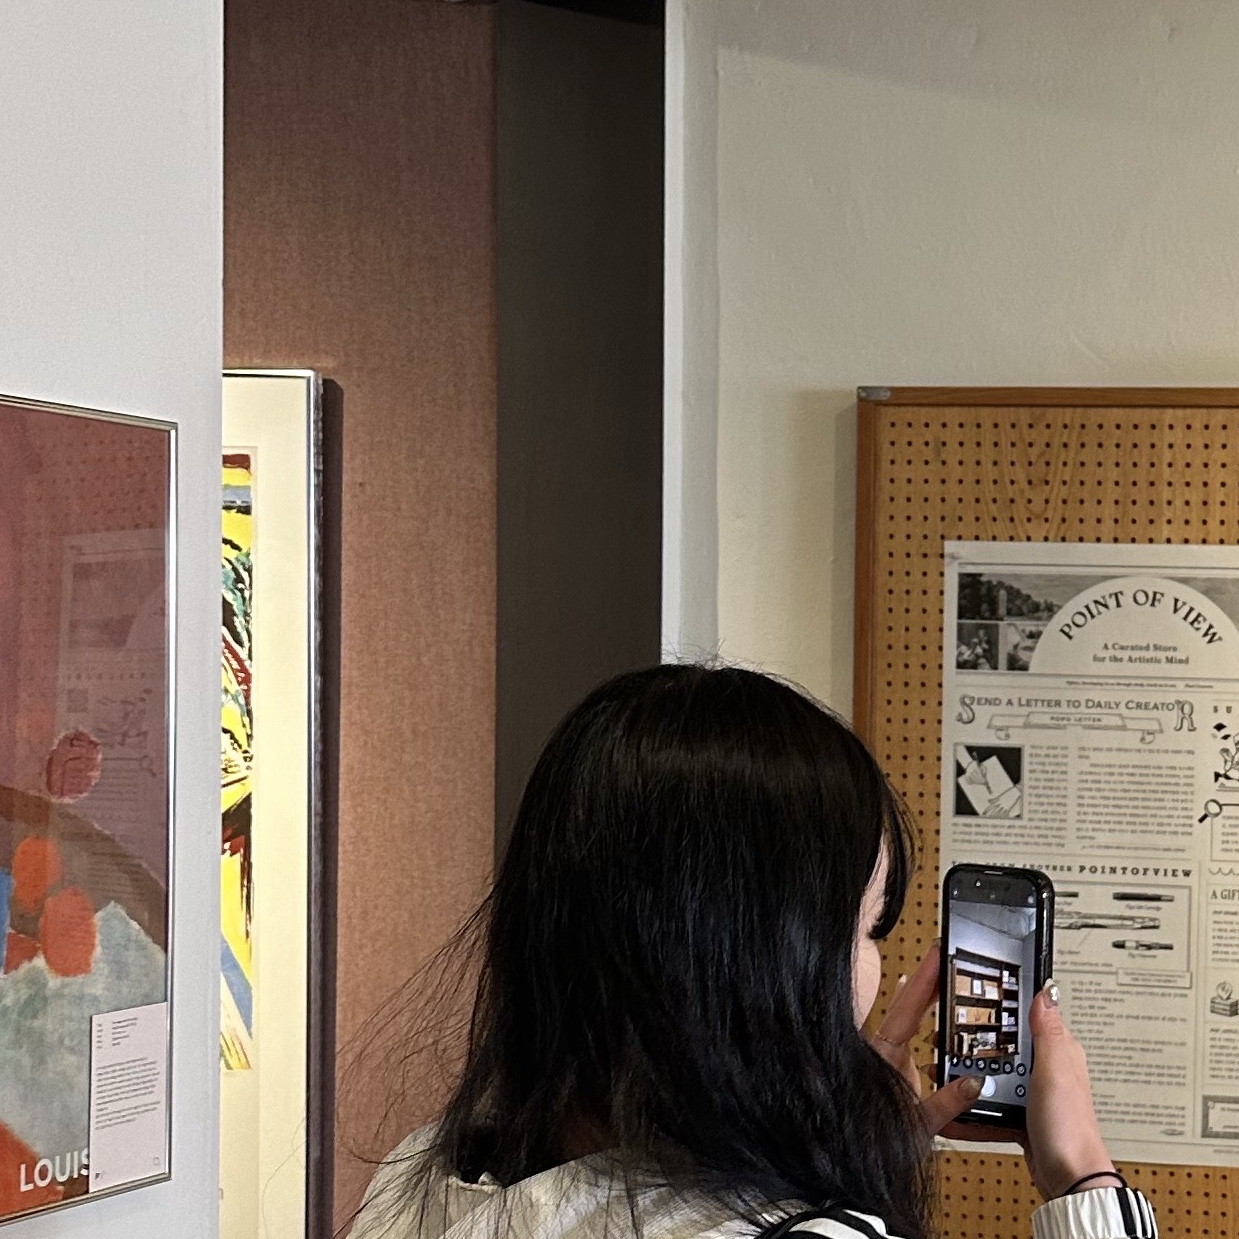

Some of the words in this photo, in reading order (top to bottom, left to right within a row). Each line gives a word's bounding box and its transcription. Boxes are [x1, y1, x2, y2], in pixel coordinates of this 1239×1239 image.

[1059, 590, 1124, 640] POINT
[1132, 589, 1165, 608] OF
[1171, 597, 1223, 645] VIEW
[1102, 643, 1109, 651] A
[1112, 643, 1150, 651] Curated
[1152, 643, 1178, 652] Store
[1092, 653, 1106, 663] for
[1109, 654, 1123, 663] the
[1126, 655, 1162, 664] Artistic
[1165, 655, 1189, 664] Mind
[1006, 697, 1014, 707] A
[1018, 696, 1062, 709] LETTER
[1066, 699, 1081, 710] TO
[1085, 699, 1120, 710] DAILY
[1211, 889, 1217, 899] A
